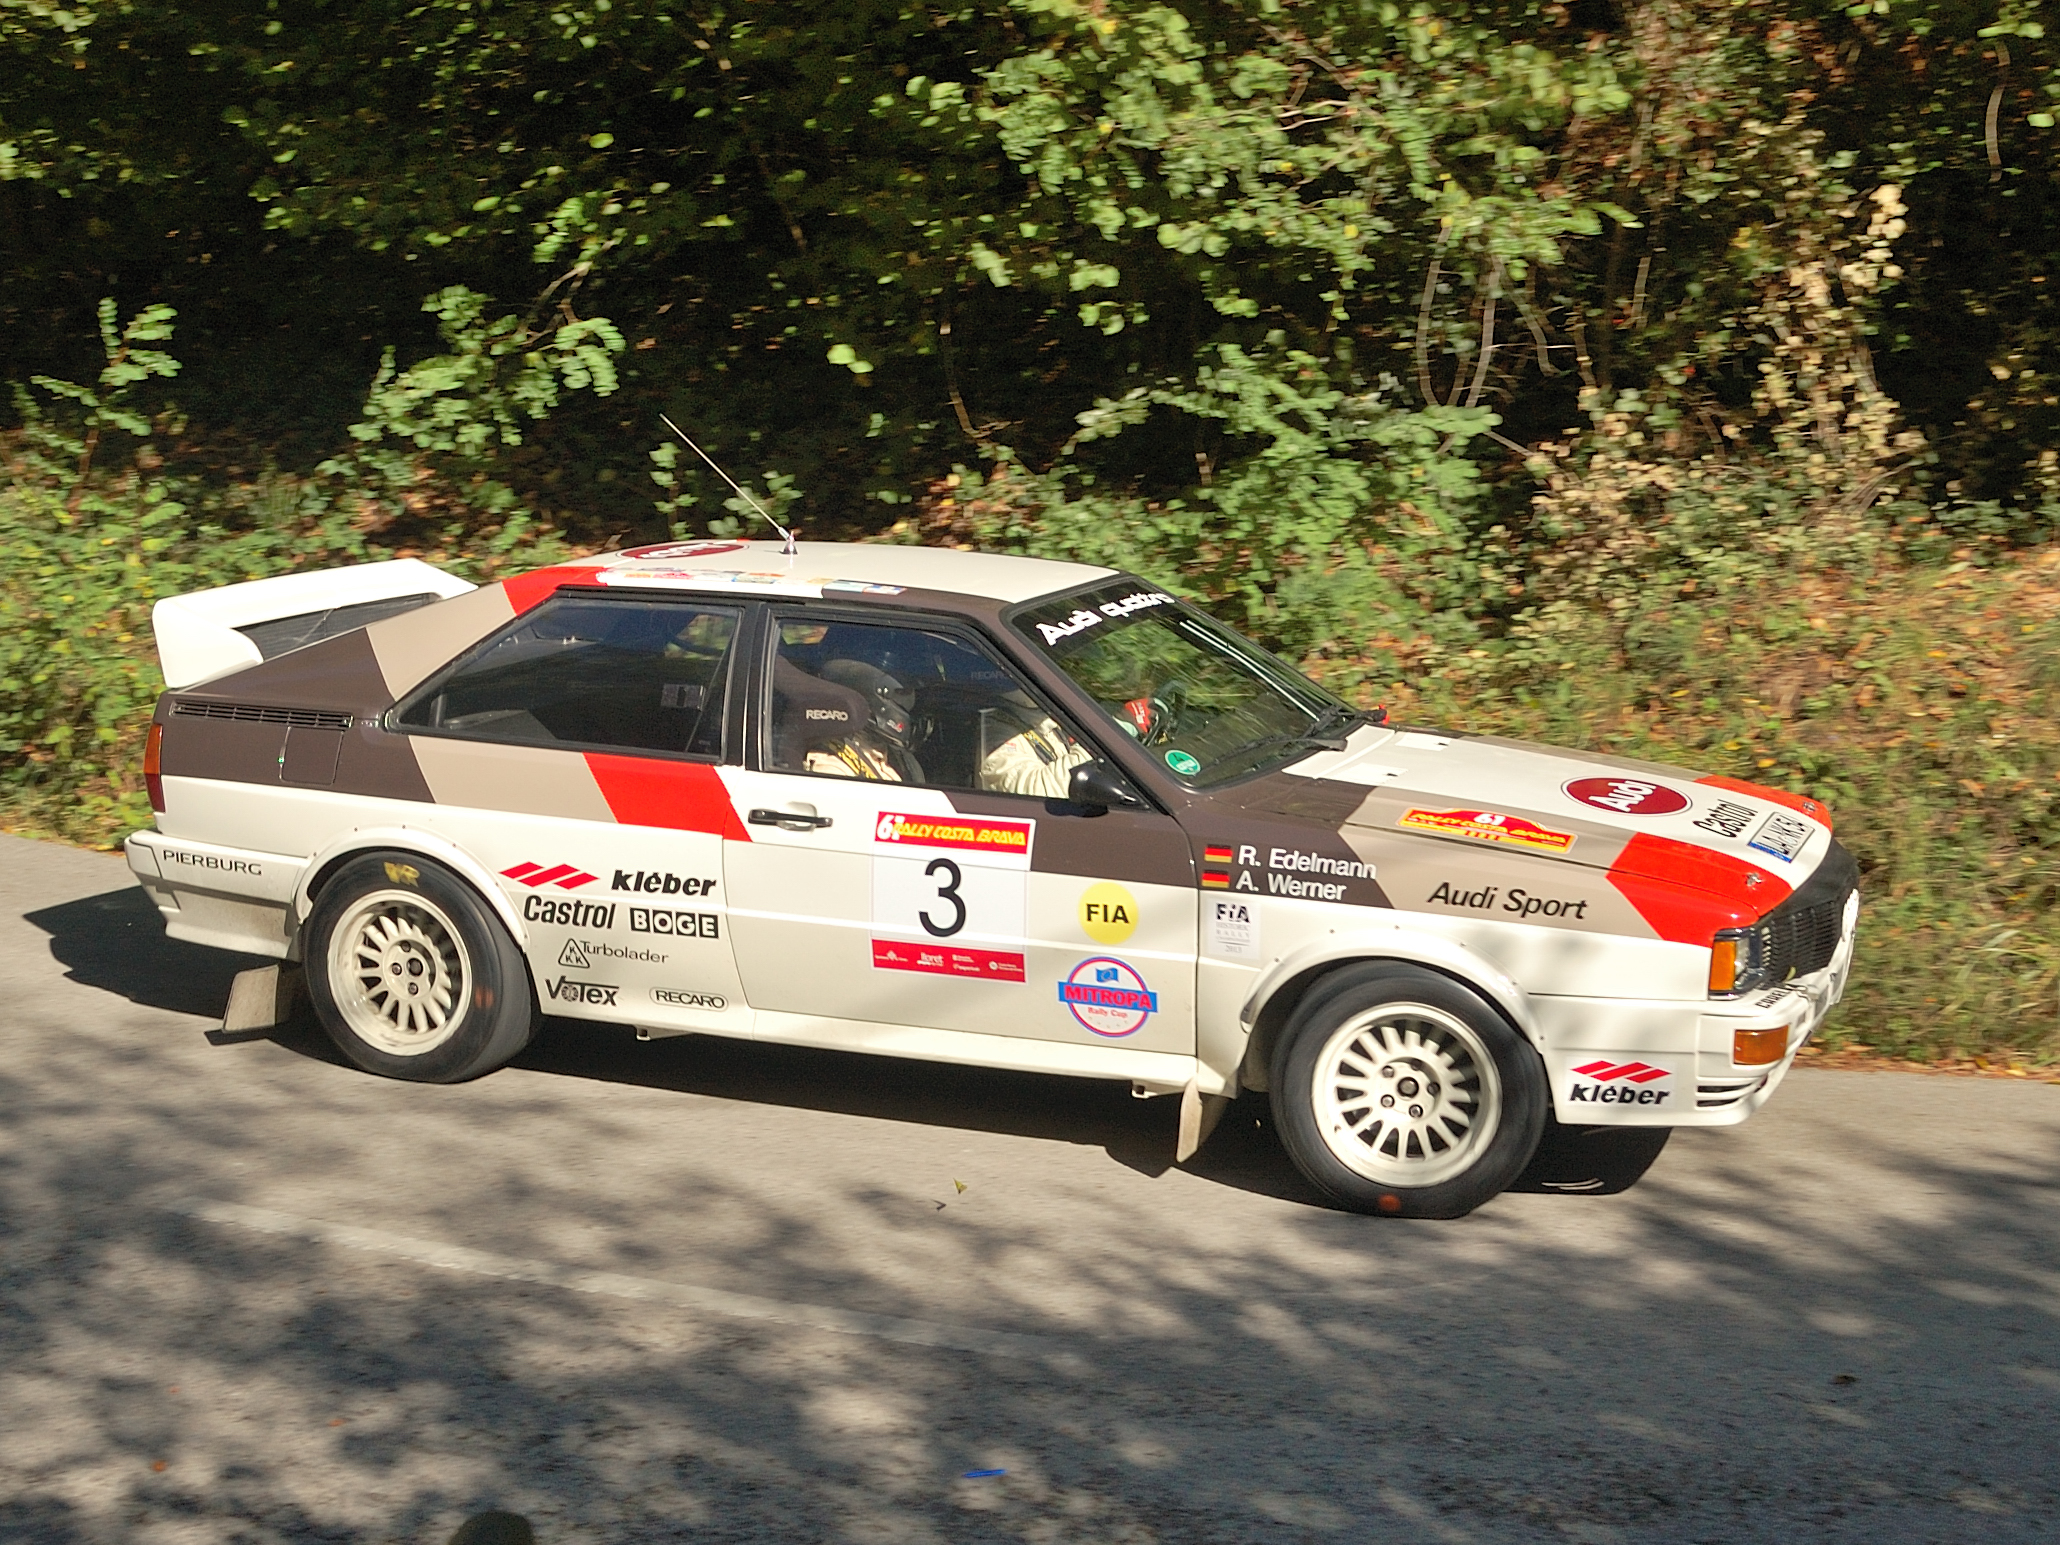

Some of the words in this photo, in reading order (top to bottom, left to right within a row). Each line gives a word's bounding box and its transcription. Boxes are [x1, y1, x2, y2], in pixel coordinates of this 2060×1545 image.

[1036, 609, 1103, 646] Audi
[1099, 592, 1176, 617] quattro
[806, 709, 848, 722] RECARO
[1589, 780, 1656, 812] Audi
[1474, 813, 1506, 826] 61
[1692, 798, 1758, 838] Castrol
[933, 826, 974, 841] COSTA
[976, 829, 1026, 846] BRAVA
[163, 849, 262, 876] PIERBURG
[1238, 845, 1261, 866] R.
[1269, 848, 1376, 879] Edelmann
[611, 869, 717, 896] kléber
[1236, 870, 1259, 892] A.
[1268, 873, 1347, 900] Werner
[918, 858, 966, 937] 3
[1426, 882, 1499, 909] Audi
[1503, 889, 1588, 920] Sport
[524, 895, 616, 929] Castrol
[630, 907, 719, 939] BOGE
[1086, 903, 1130, 924] FIA
[580, 940, 669, 963] Turbolader
[655, 989, 725, 1009] RECARO
[1064, 985, 1153, 1009] MITROPA
[1569, 1083, 1671, 1105] kléber
